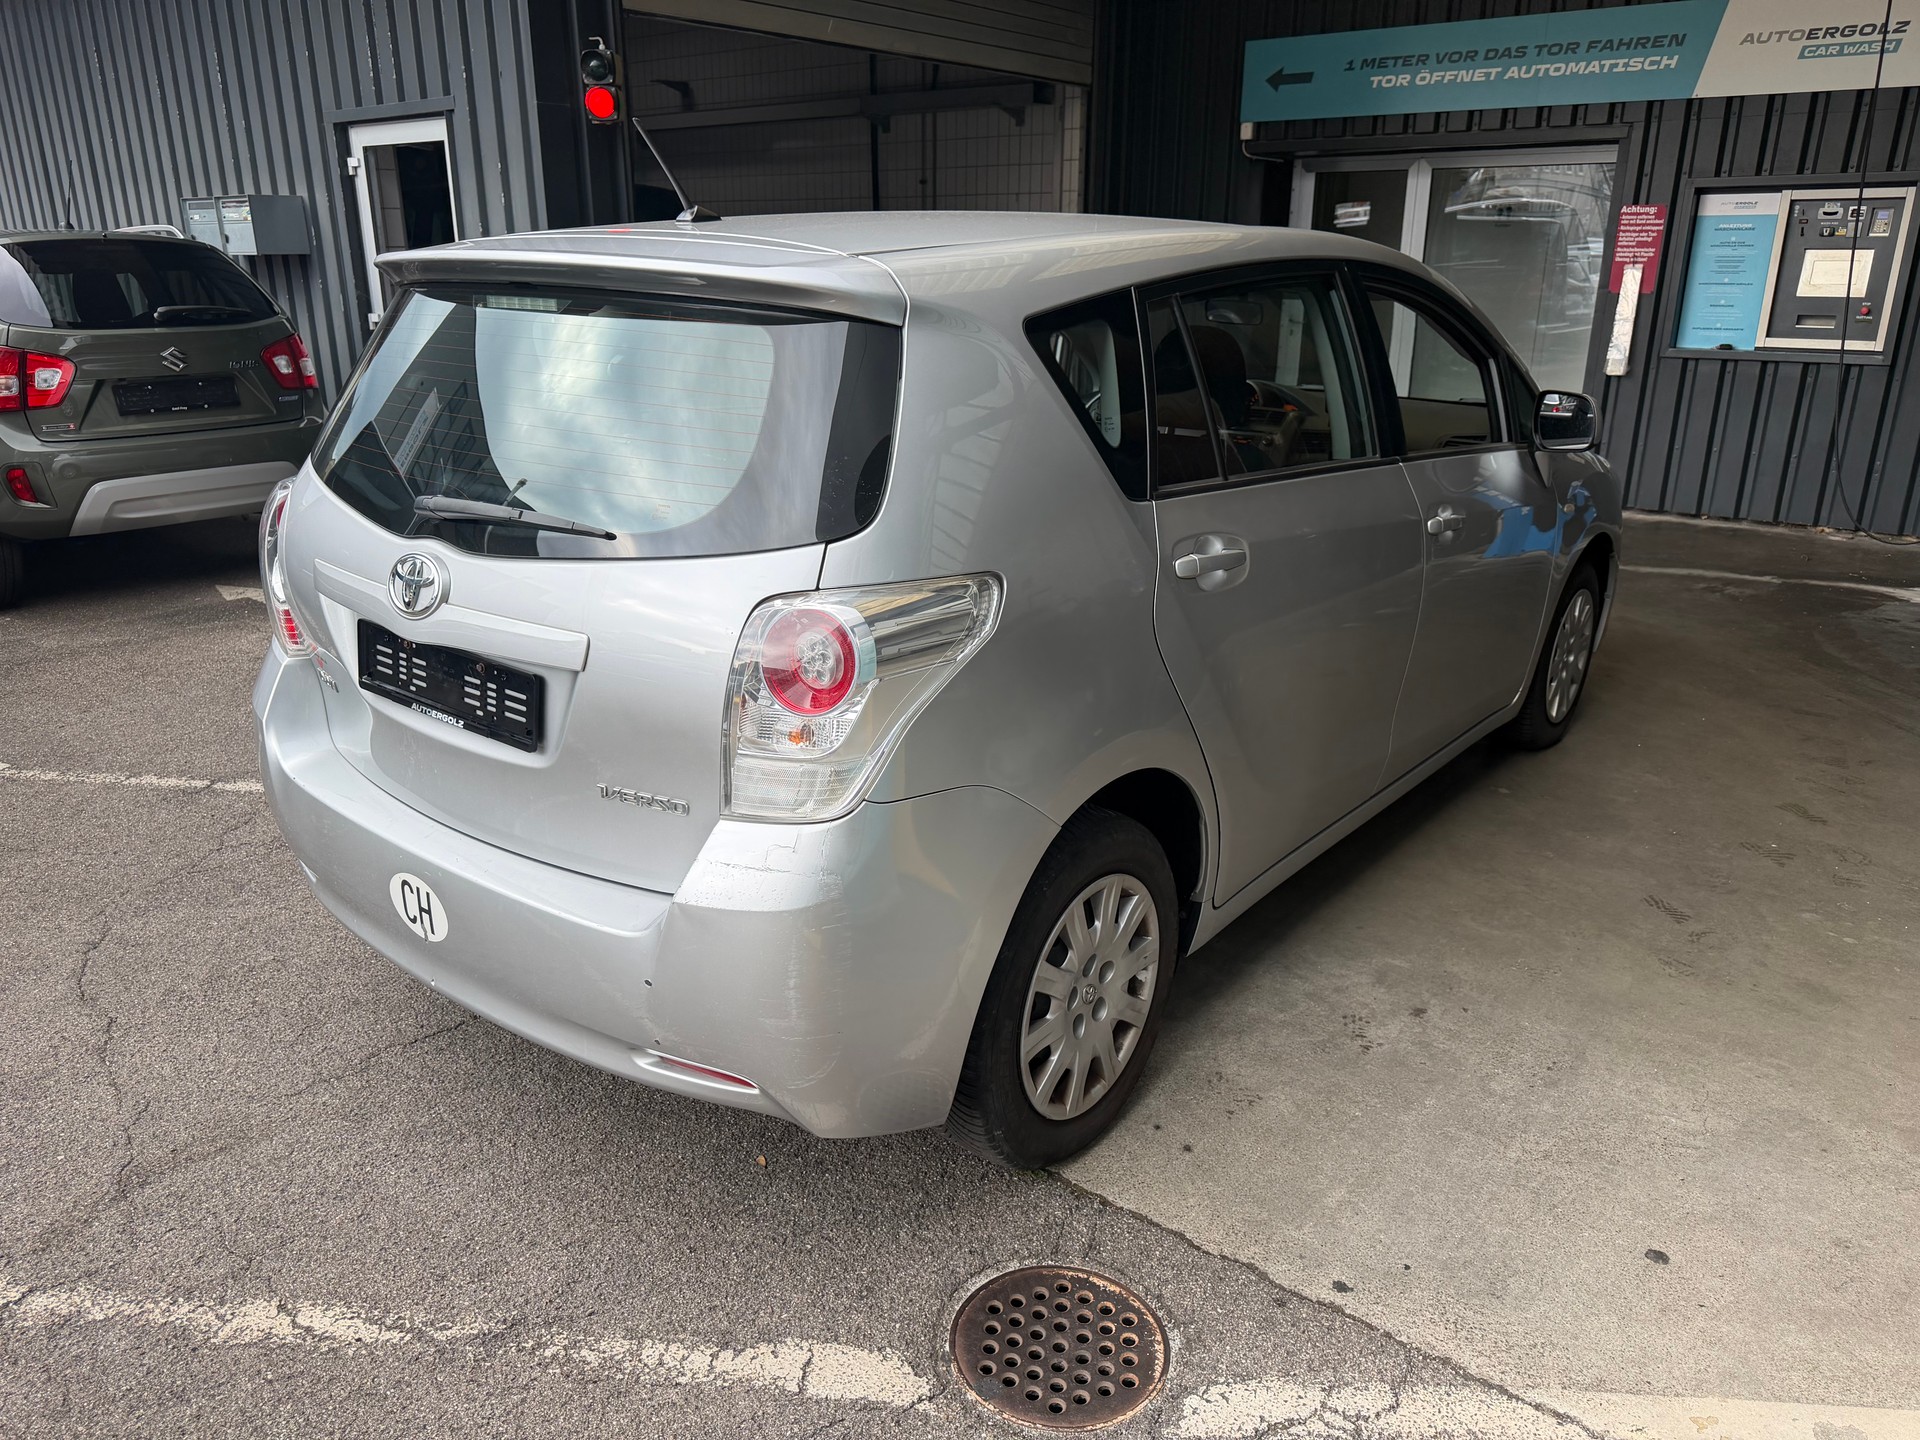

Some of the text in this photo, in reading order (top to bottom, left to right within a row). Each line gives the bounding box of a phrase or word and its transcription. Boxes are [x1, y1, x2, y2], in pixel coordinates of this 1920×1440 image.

[1739, 20, 1911, 45] AUTOERGOLZ
[1344, 33, 1687, 71] 1 METER VOR DAS TOR FAHREN
[1803, 41, 1897, 57] CAR WASH
[1370, 55, 1679, 88] TOR ÖFFNET AUTOMATISCH
[1621, 205, 1657, 214] Achtung:
[411, 702, 464, 728] AUTOERGOLZ
[597, 783, 690, 816] VERSO
[401, 879, 435, 935] CH
